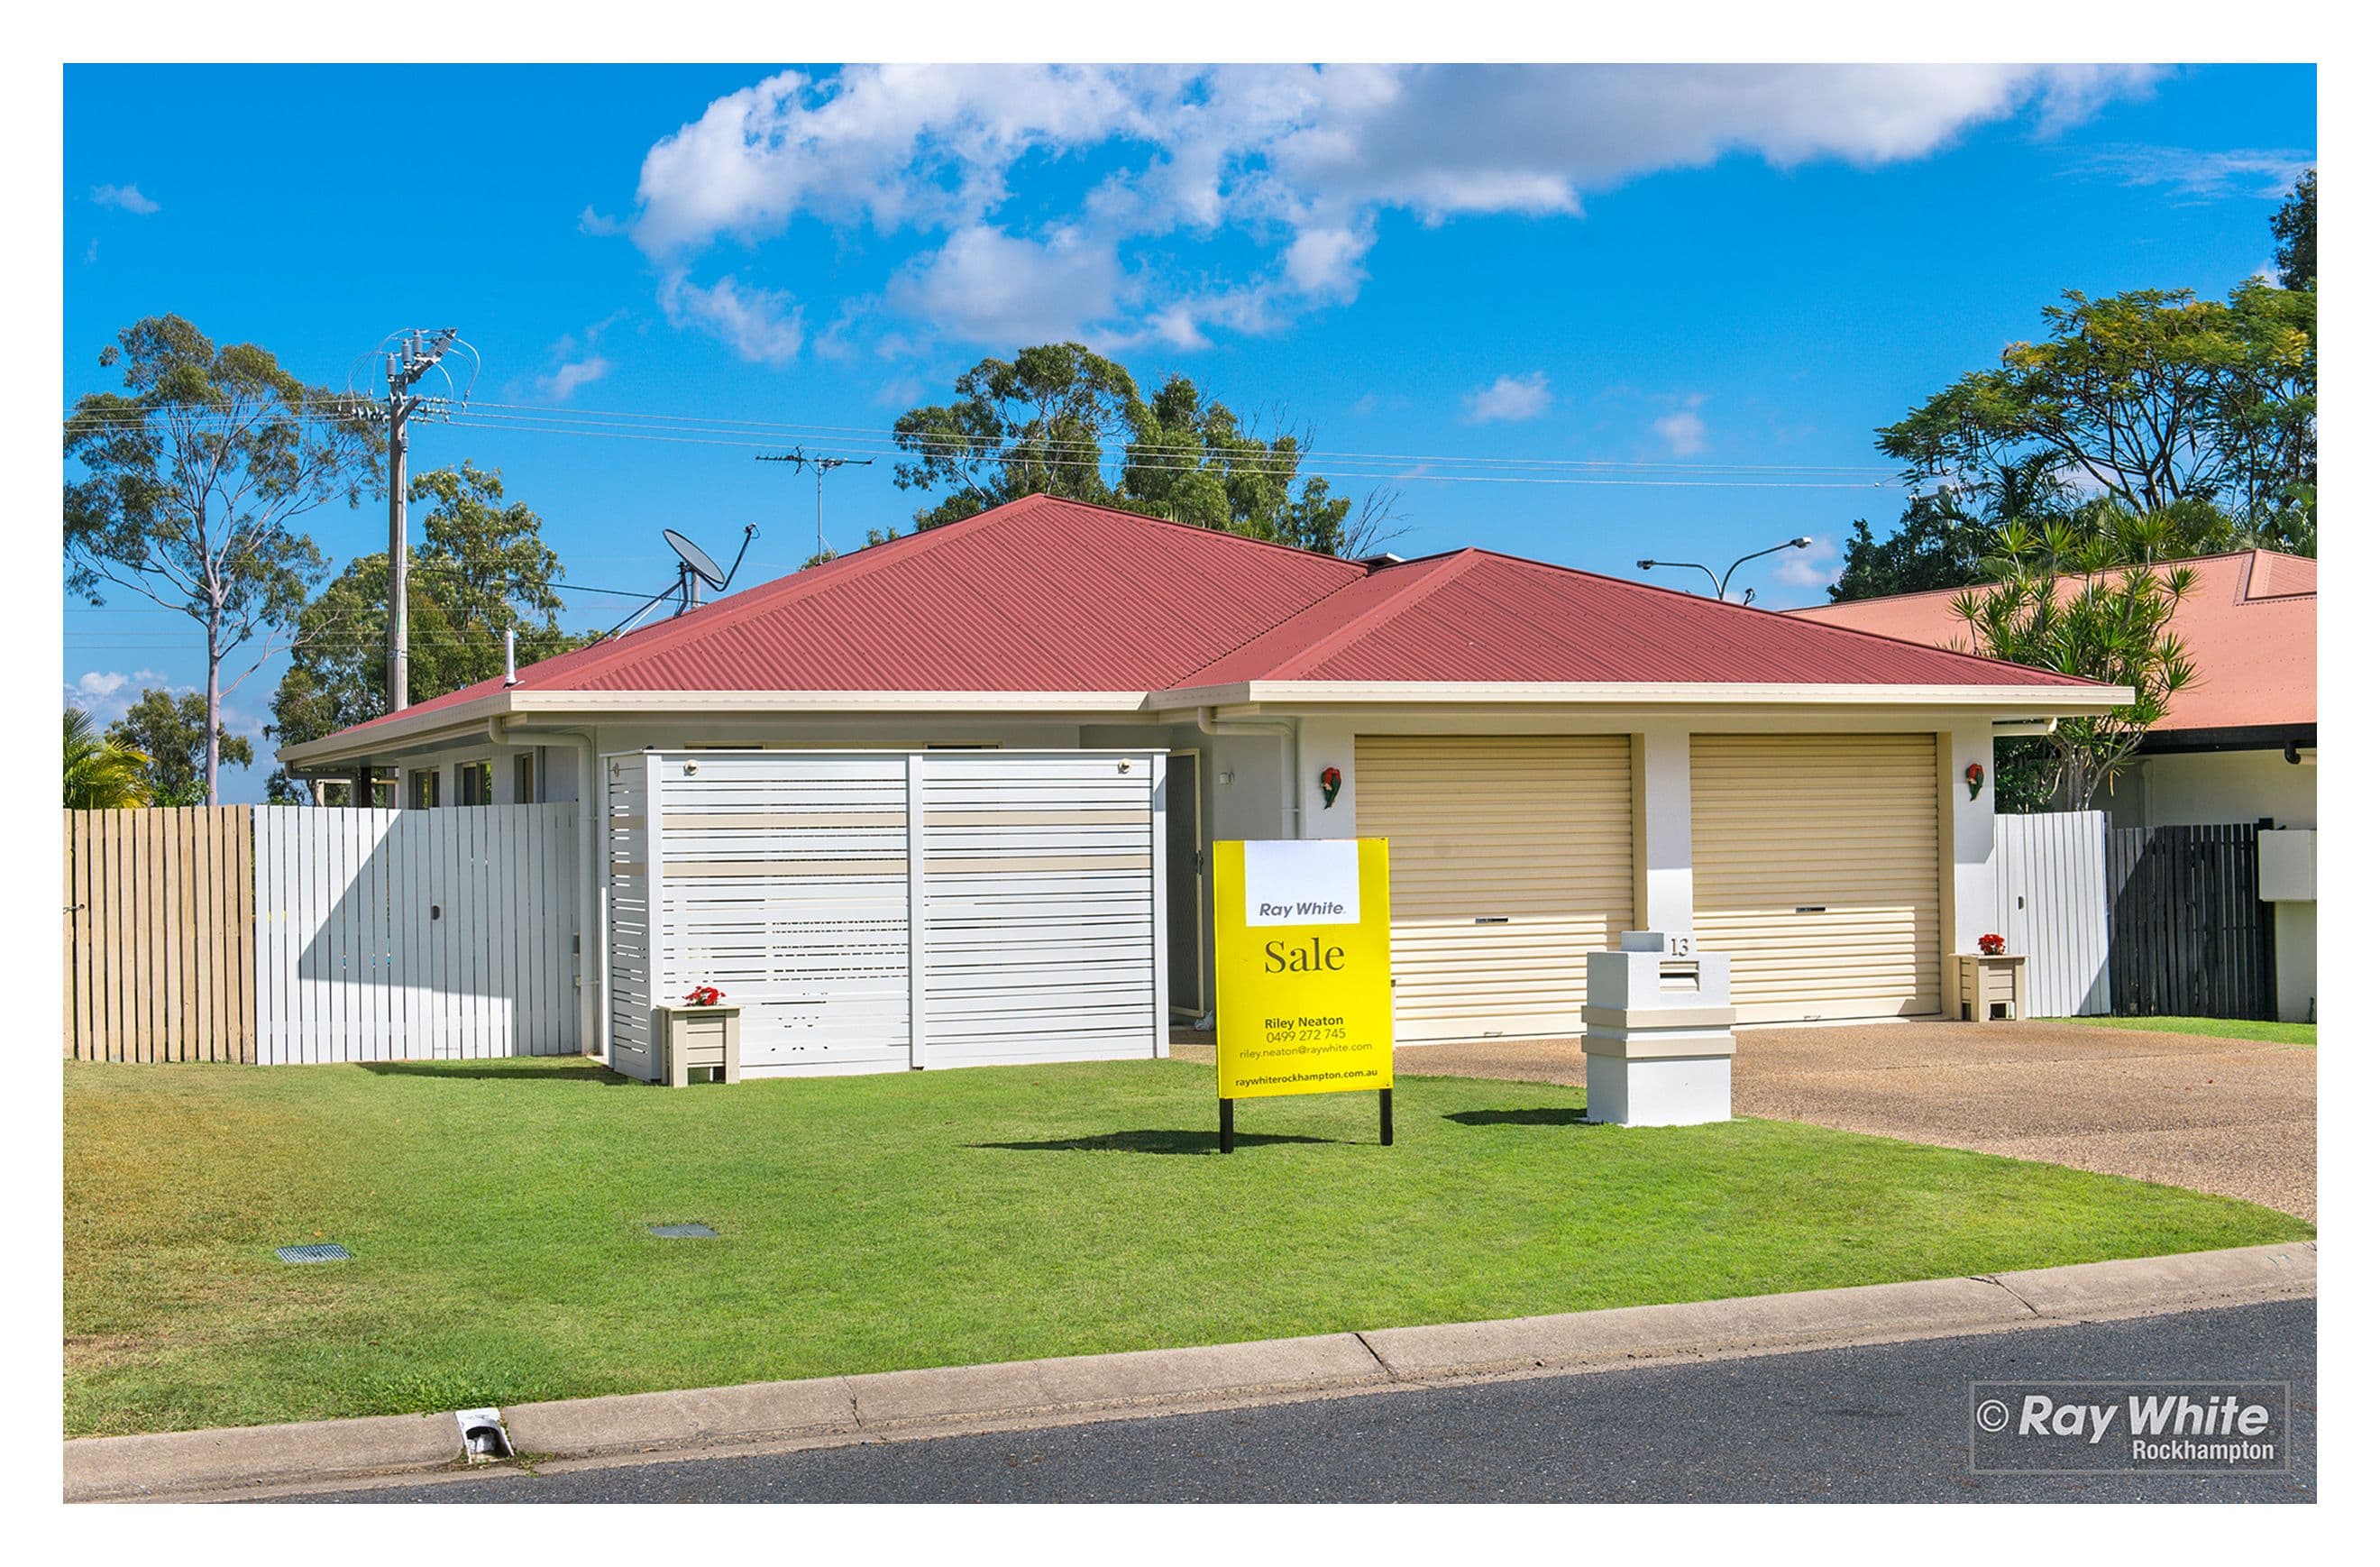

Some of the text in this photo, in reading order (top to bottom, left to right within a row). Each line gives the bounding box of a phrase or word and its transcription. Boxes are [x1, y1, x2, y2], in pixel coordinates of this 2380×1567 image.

[1259, 903, 1294, 918] Ray
[1265, 937, 1345, 974] Sale
[1671, 938, 1689, 957] 13
[1265, 1015, 1343, 1031] Riley Neaton
[1267, 1028, 1346, 1044] 0499 272 745
[1240, 1043, 1373, 1060] riley.neaton@raywhite.com
[1235, 1069, 1378, 1087] raywhiterockhampton.com.au
